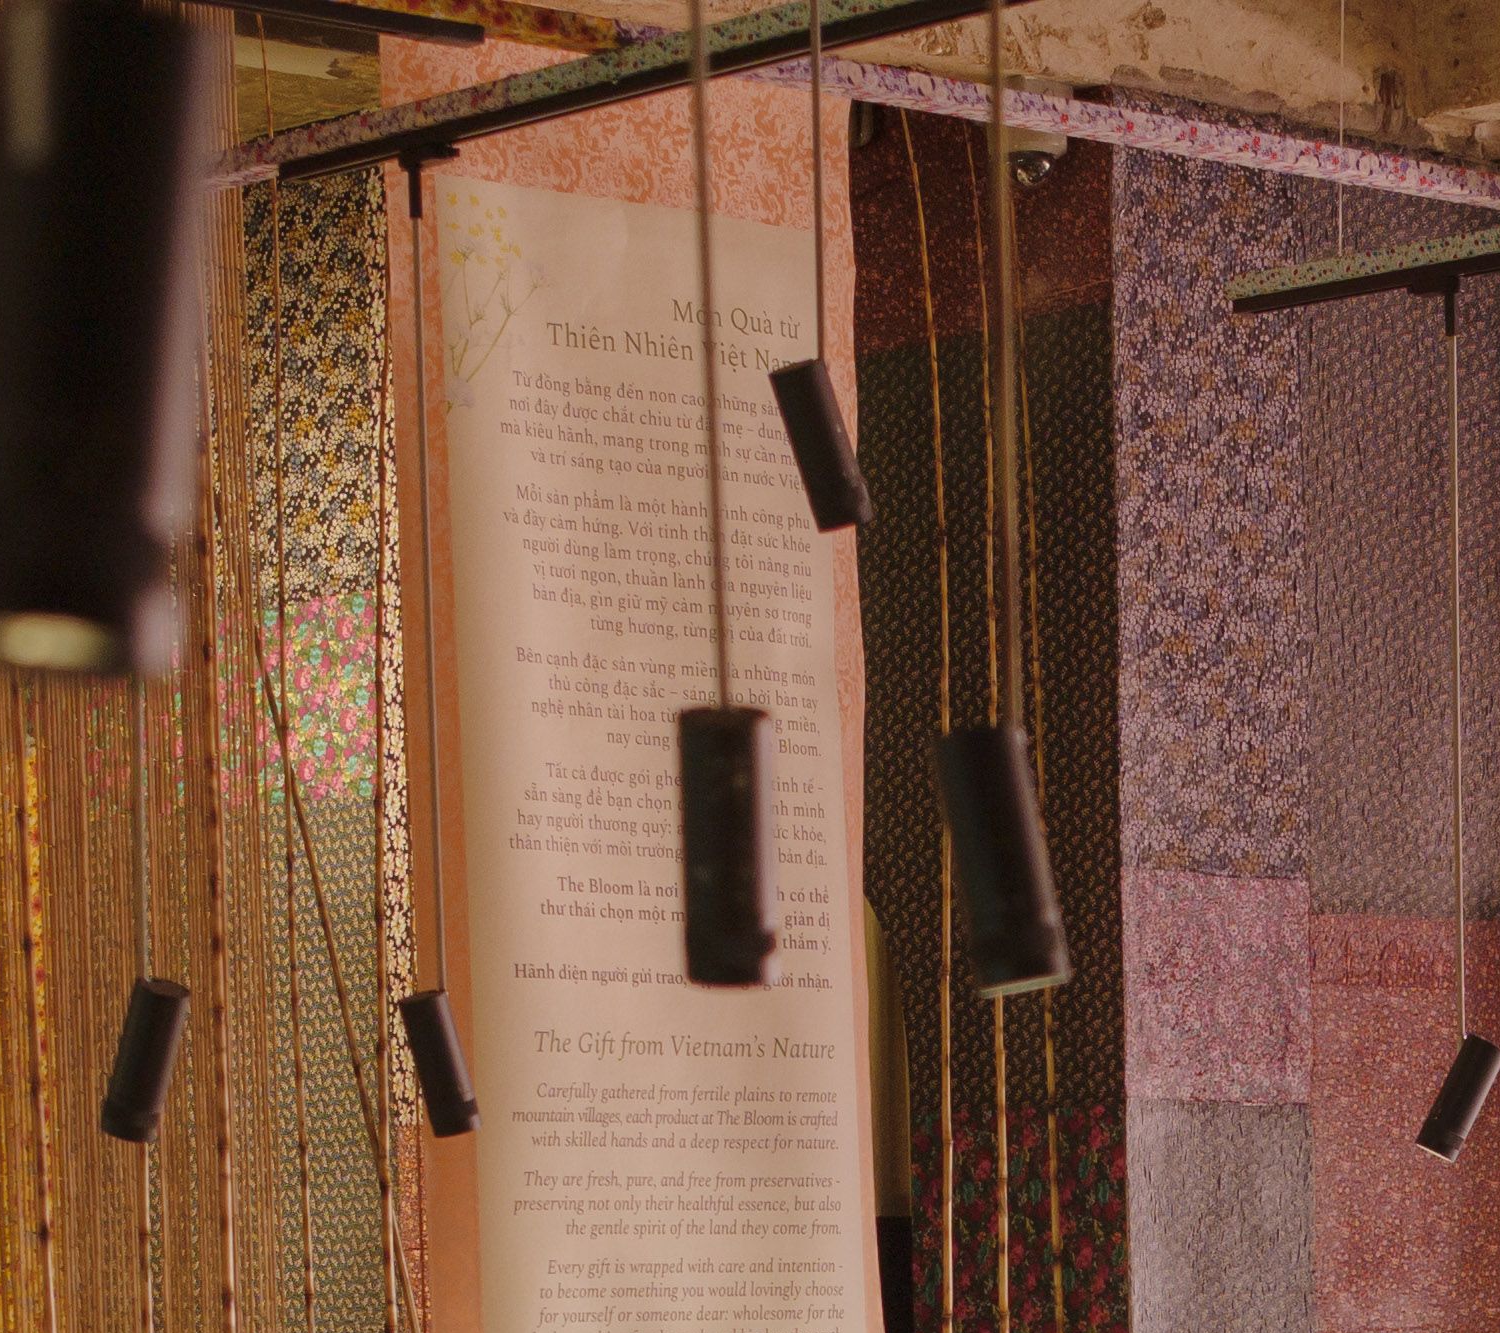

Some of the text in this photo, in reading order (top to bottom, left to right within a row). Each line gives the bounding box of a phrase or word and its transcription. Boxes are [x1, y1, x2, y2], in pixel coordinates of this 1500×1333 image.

[730, 307, 774, 336] Quà
[779, 315, 800, 340] từ
[546, 322, 616, 352] Thiên
[623, 330, 694, 361] Nhiên
[534, 1031, 571, 1053] The
[578, 1032, 616, 1061] Gift
[618, 1032, 664, 1061] from
[772, 1037, 835, 1059] Nature
[537, 1082, 837, 1106] Carefully gathered from fertile plains to remote
[512, 1110, 575, 1123] mountain
[626, 1108, 652, 1124] each
[655, 1109, 698, 1128] product
[702, 1111, 715, 1125] at
[717, 1110, 740, 1125] The
[743, 1109, 784, 1126] Bloom
[787, 1111, 797, 1126] is
[800, 1111, 838, 1130] crafted
[532, 1130, 561, 1147] with
[565, 1131, 607, 1147] skilled
[611, 1131, 648, 1148] hands
[652, 1132, 675, 1148] and
[679, 1138, 686, 1148] a
[690, 1133, 719, 1153] deep
[724, 1138, 769, 1154] respect
[771, 1136, 793, 1154] for
[524, 1170, 558, 1191] They
[563, 1176, 583, 1187] are
[661, 1171, 683, 1187] and
[688, 1171, 712, 1191] free
[714, 1172, 746, 1192] from
[750, 1173, 833, 1192] preservatives
[514, 1196, 584, 1215] preserving
[588, 1200, 610, 1211] not
[614, 1195, 641, 1215] only
[646, 1195, 674, 1211] their
[678, 1195, 734, 1216] healthful
[794, 1195, 815, 1211] but
[819, 1195, 841, 1211] also
[566, 1219, 586, 1235] the
[590, 1219, 630, 1240] gentle
[633, 1220, 666, 1239] spirit
[670, 1219, 684, 1239] of
[687, 1219, 705, 1235] the
[710, 1219, 737, 1235] land
[742, 1219, 769, 1239] they
[773, 1224, 807, 1235] come
[548, 1260, 585, 1279] Every
[588, 1258, 610, 1279] gift
[615, 1259, 625, 1274] is
[629, 1257, 683, 1278] wrapped
[688, 1257, 714, 1273] with
[718, 1263, 745, 1273] care
[749, 1257, 774, 1273] and
[778, 1258, 835, 1273] intention
[540, 1280, 844, 1302] to become something you would lovingly choose
[537, 1307, 559, 1328] for
[563, 1306, 616, 1327] yourself
[618, 1312, 633, 1322] or
[636, 1311, 692, 1322] someone
[733, 1304, 803, 1320] wholesome
[805, 1304, 825, 1324] for
[828, 1304, 844, 1319] the
